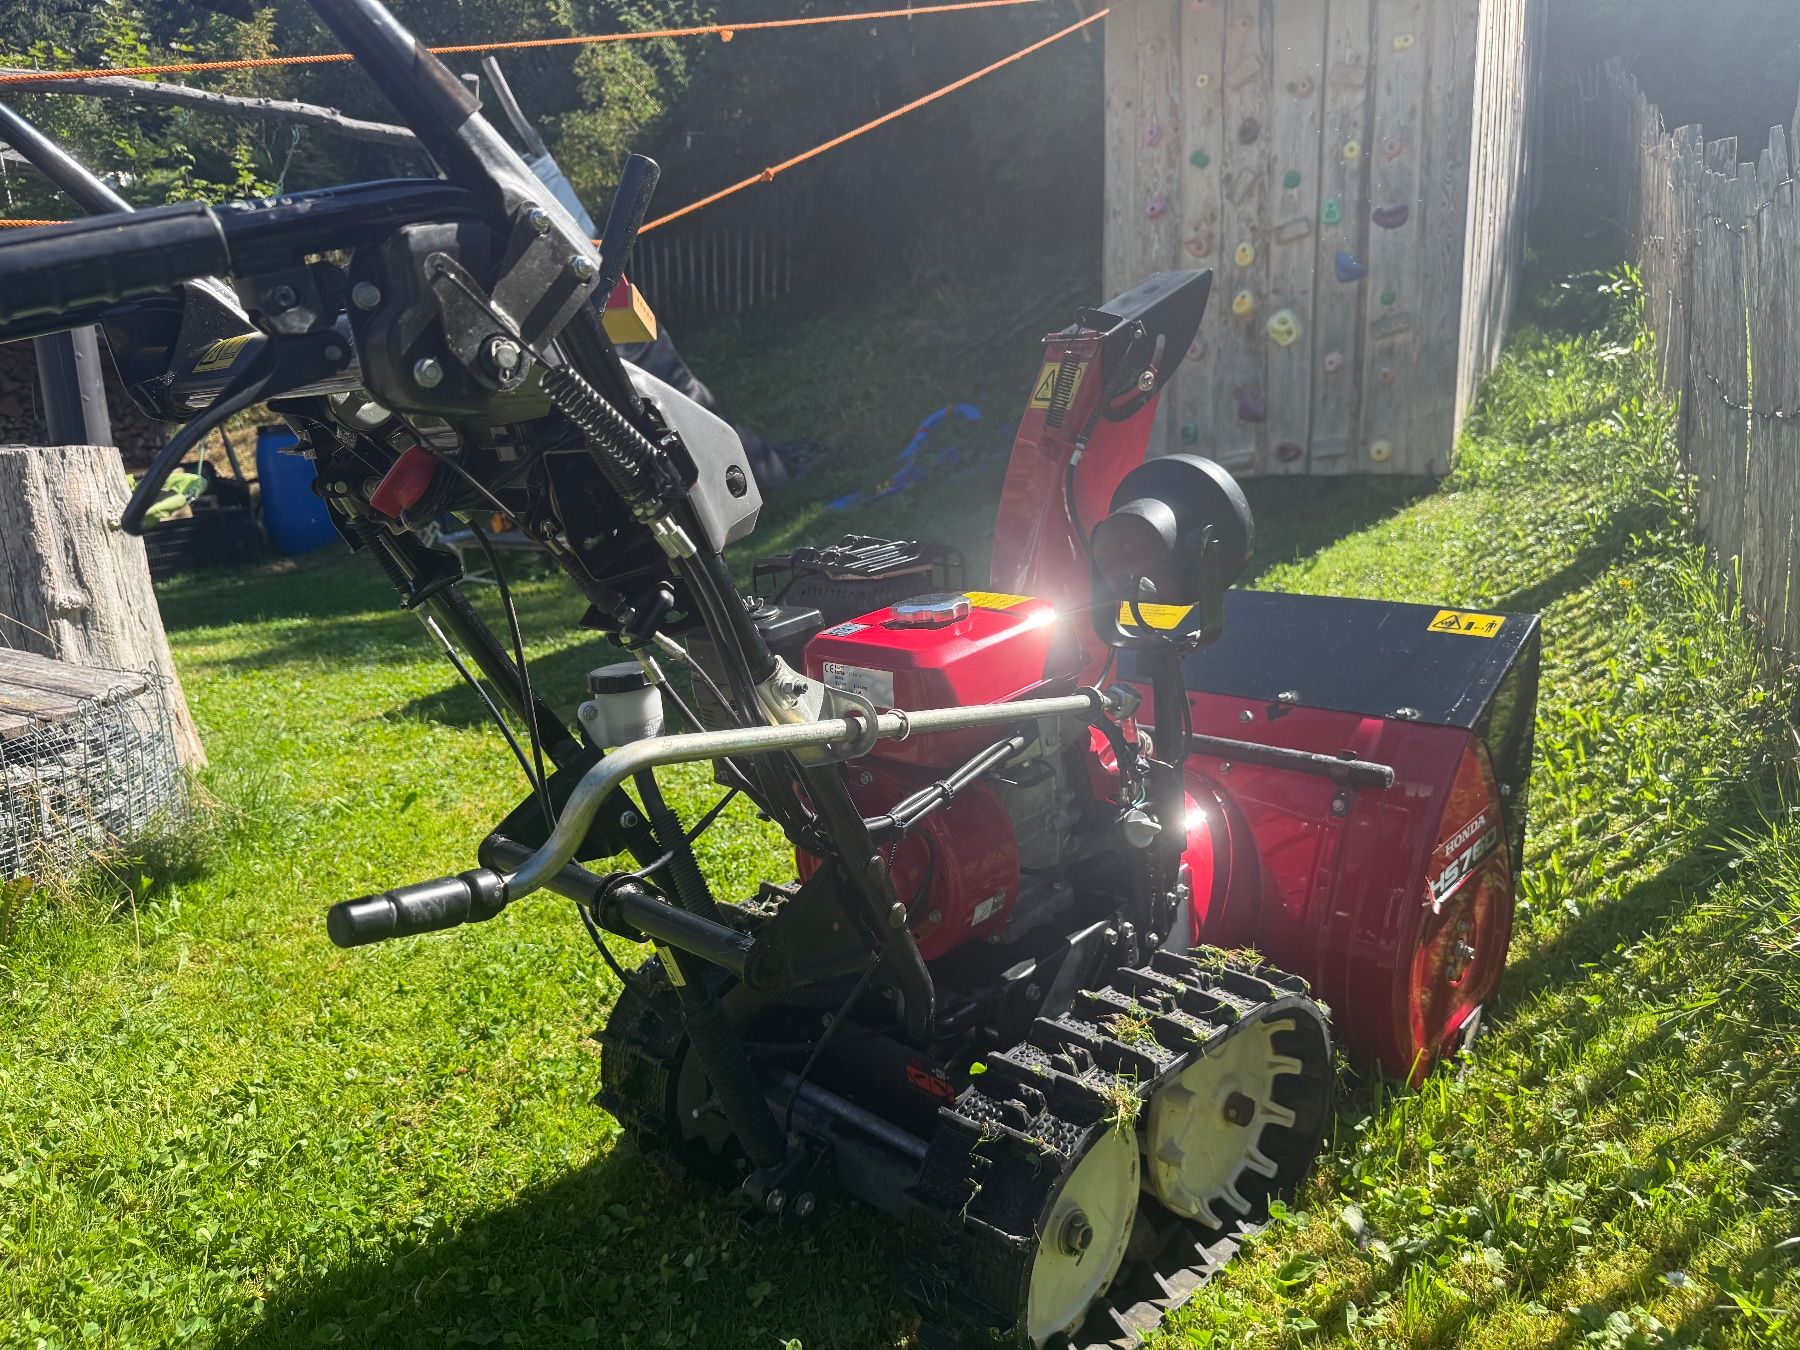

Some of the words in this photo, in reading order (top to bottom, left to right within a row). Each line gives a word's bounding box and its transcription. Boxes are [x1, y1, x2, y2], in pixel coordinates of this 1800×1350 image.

[824, 663, 834, 674] CE
[1445, 815, 1486, 857] HONDA
[1430, 825, 1497, 893] HS760
